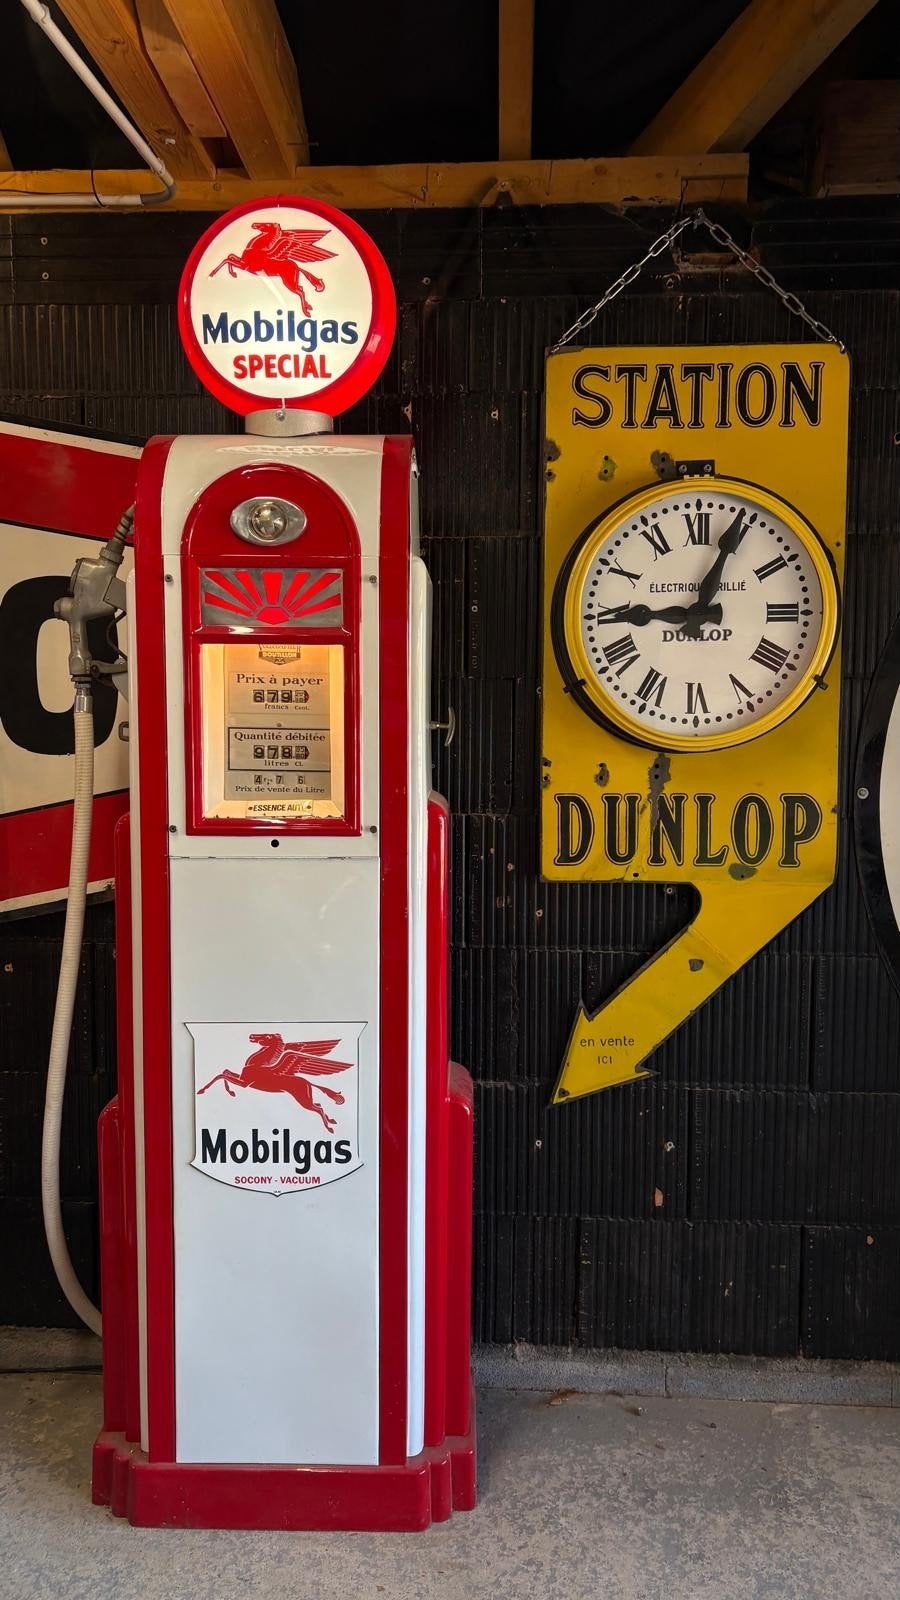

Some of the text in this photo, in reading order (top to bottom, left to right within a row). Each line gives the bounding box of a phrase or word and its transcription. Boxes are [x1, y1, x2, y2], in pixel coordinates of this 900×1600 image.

[202, 310, 359, 352] Mobilgas
[233, 354, 332, 379] SPECIAL
[572, 362, 825, 429] STATION
[681, 512, 713, 547] XII
[639, 522, 673, 562] XI
[607, 558, 643, 589] X
[649, 580, 747, 593] ÉLECTRIQU RILLIÉ
[662, 629, 733, 642] DULOP
[236, 673, 324, 686] Prix à payer
[234, 731, 326, 741] Quantité débitée
[235, 785, 252, 793] Prix
[253, 804, 286, 812] ESSENCE
[554, 793, 822, 867] DUNLOP
[580, 1035, 635, 1048] en vente
[201, 1128, 353, 1175] Mobilgas
[234, 1176, 272, 1184] SOCONY
[279, 1176, 321, 1184] VACUUM
